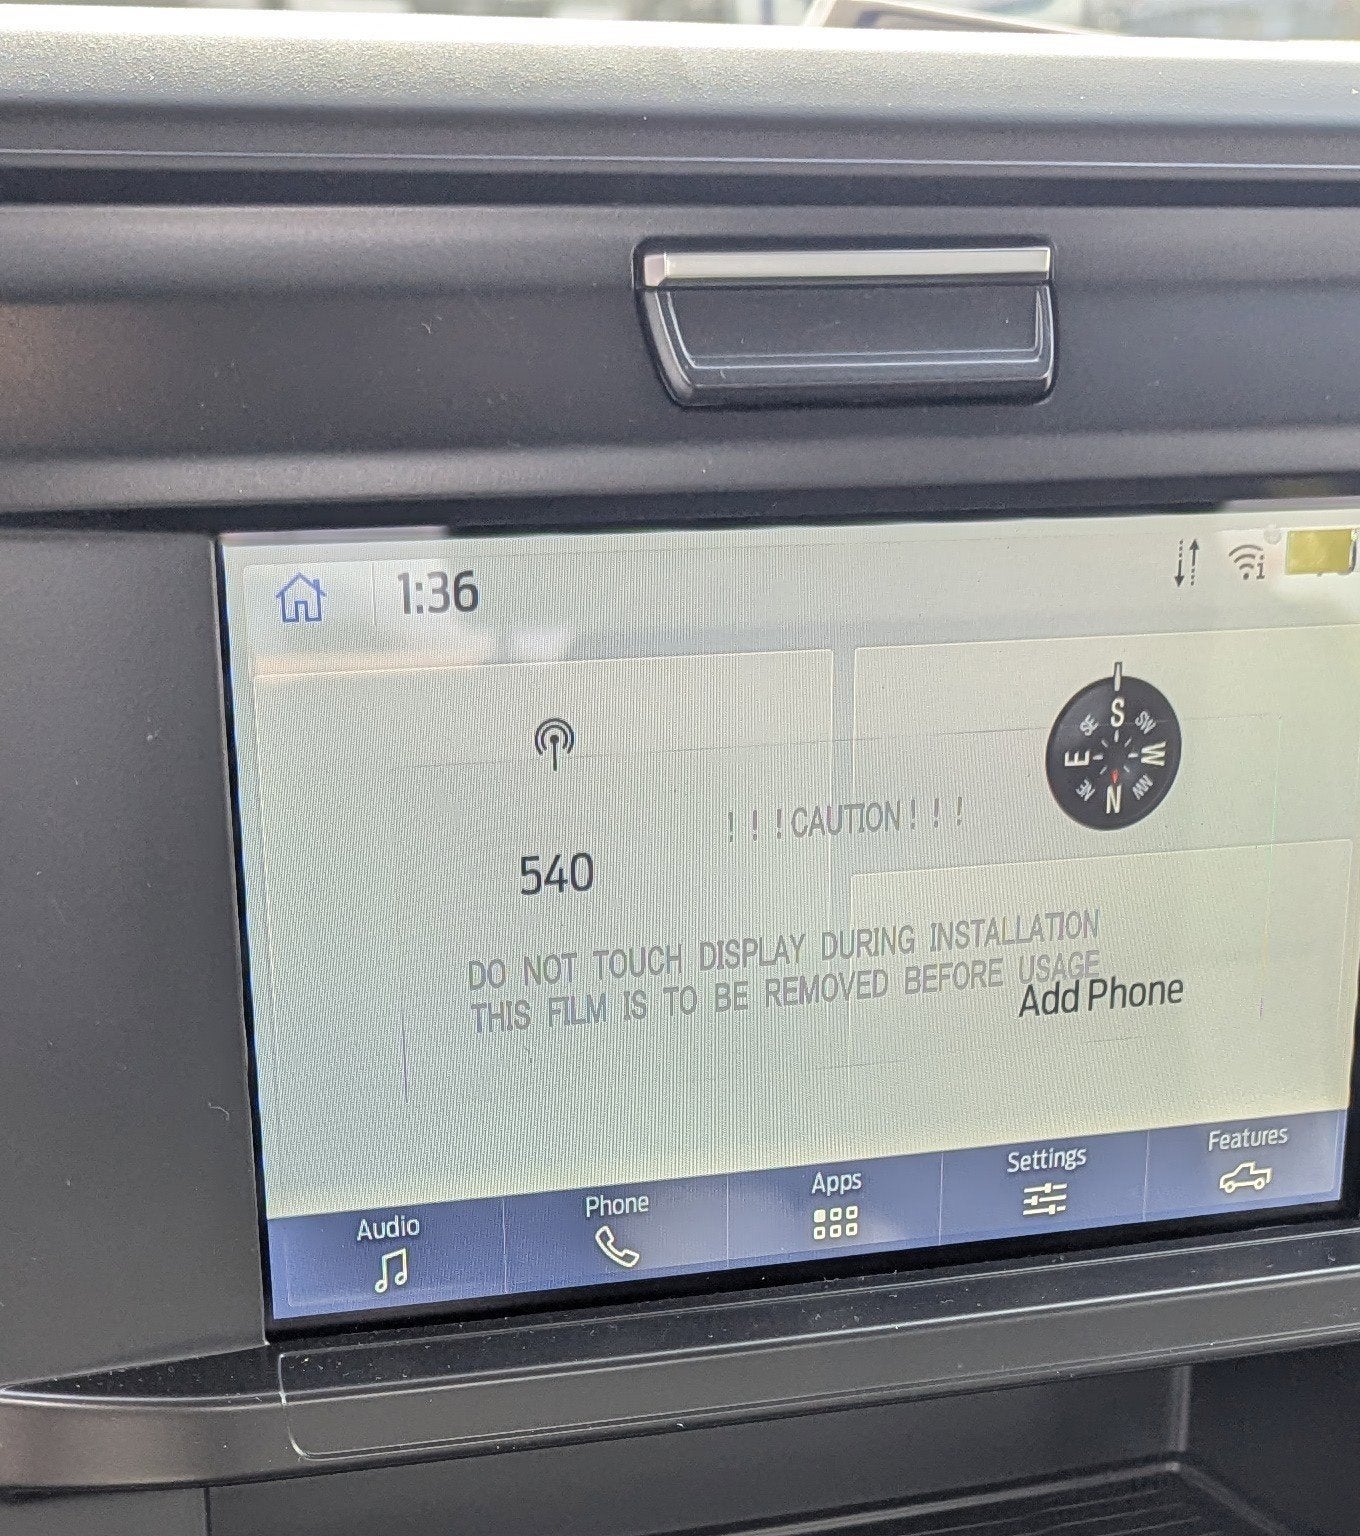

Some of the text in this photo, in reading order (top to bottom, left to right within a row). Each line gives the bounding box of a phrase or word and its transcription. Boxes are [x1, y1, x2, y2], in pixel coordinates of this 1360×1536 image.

[398, 569, 479, 615] 1:36
[1110, 696, 1125, 728] S
[1064, 750, 1091, 768] E
[1105, 783, 1123, 815] N
[520, 851, 594, 895] 540
[468, 908, 1101, 991] DO NOT TOUCH DISPLAY DURING INSTALLATION
[470, 949, 1101, 1034] THIS FILM IS TO BE REMOVED BEFORE USAGE
[1018, 975, 1185, 1018] Add Phone
[1207, 1125, 1289, 1152] Features
[1006, 1145, 1088, 1174] Settings
[810, 1170, 863, 1197] Apps
[584, 1193, 650, 1219] Phone
[355, 1214, 420, 1242] Audio
